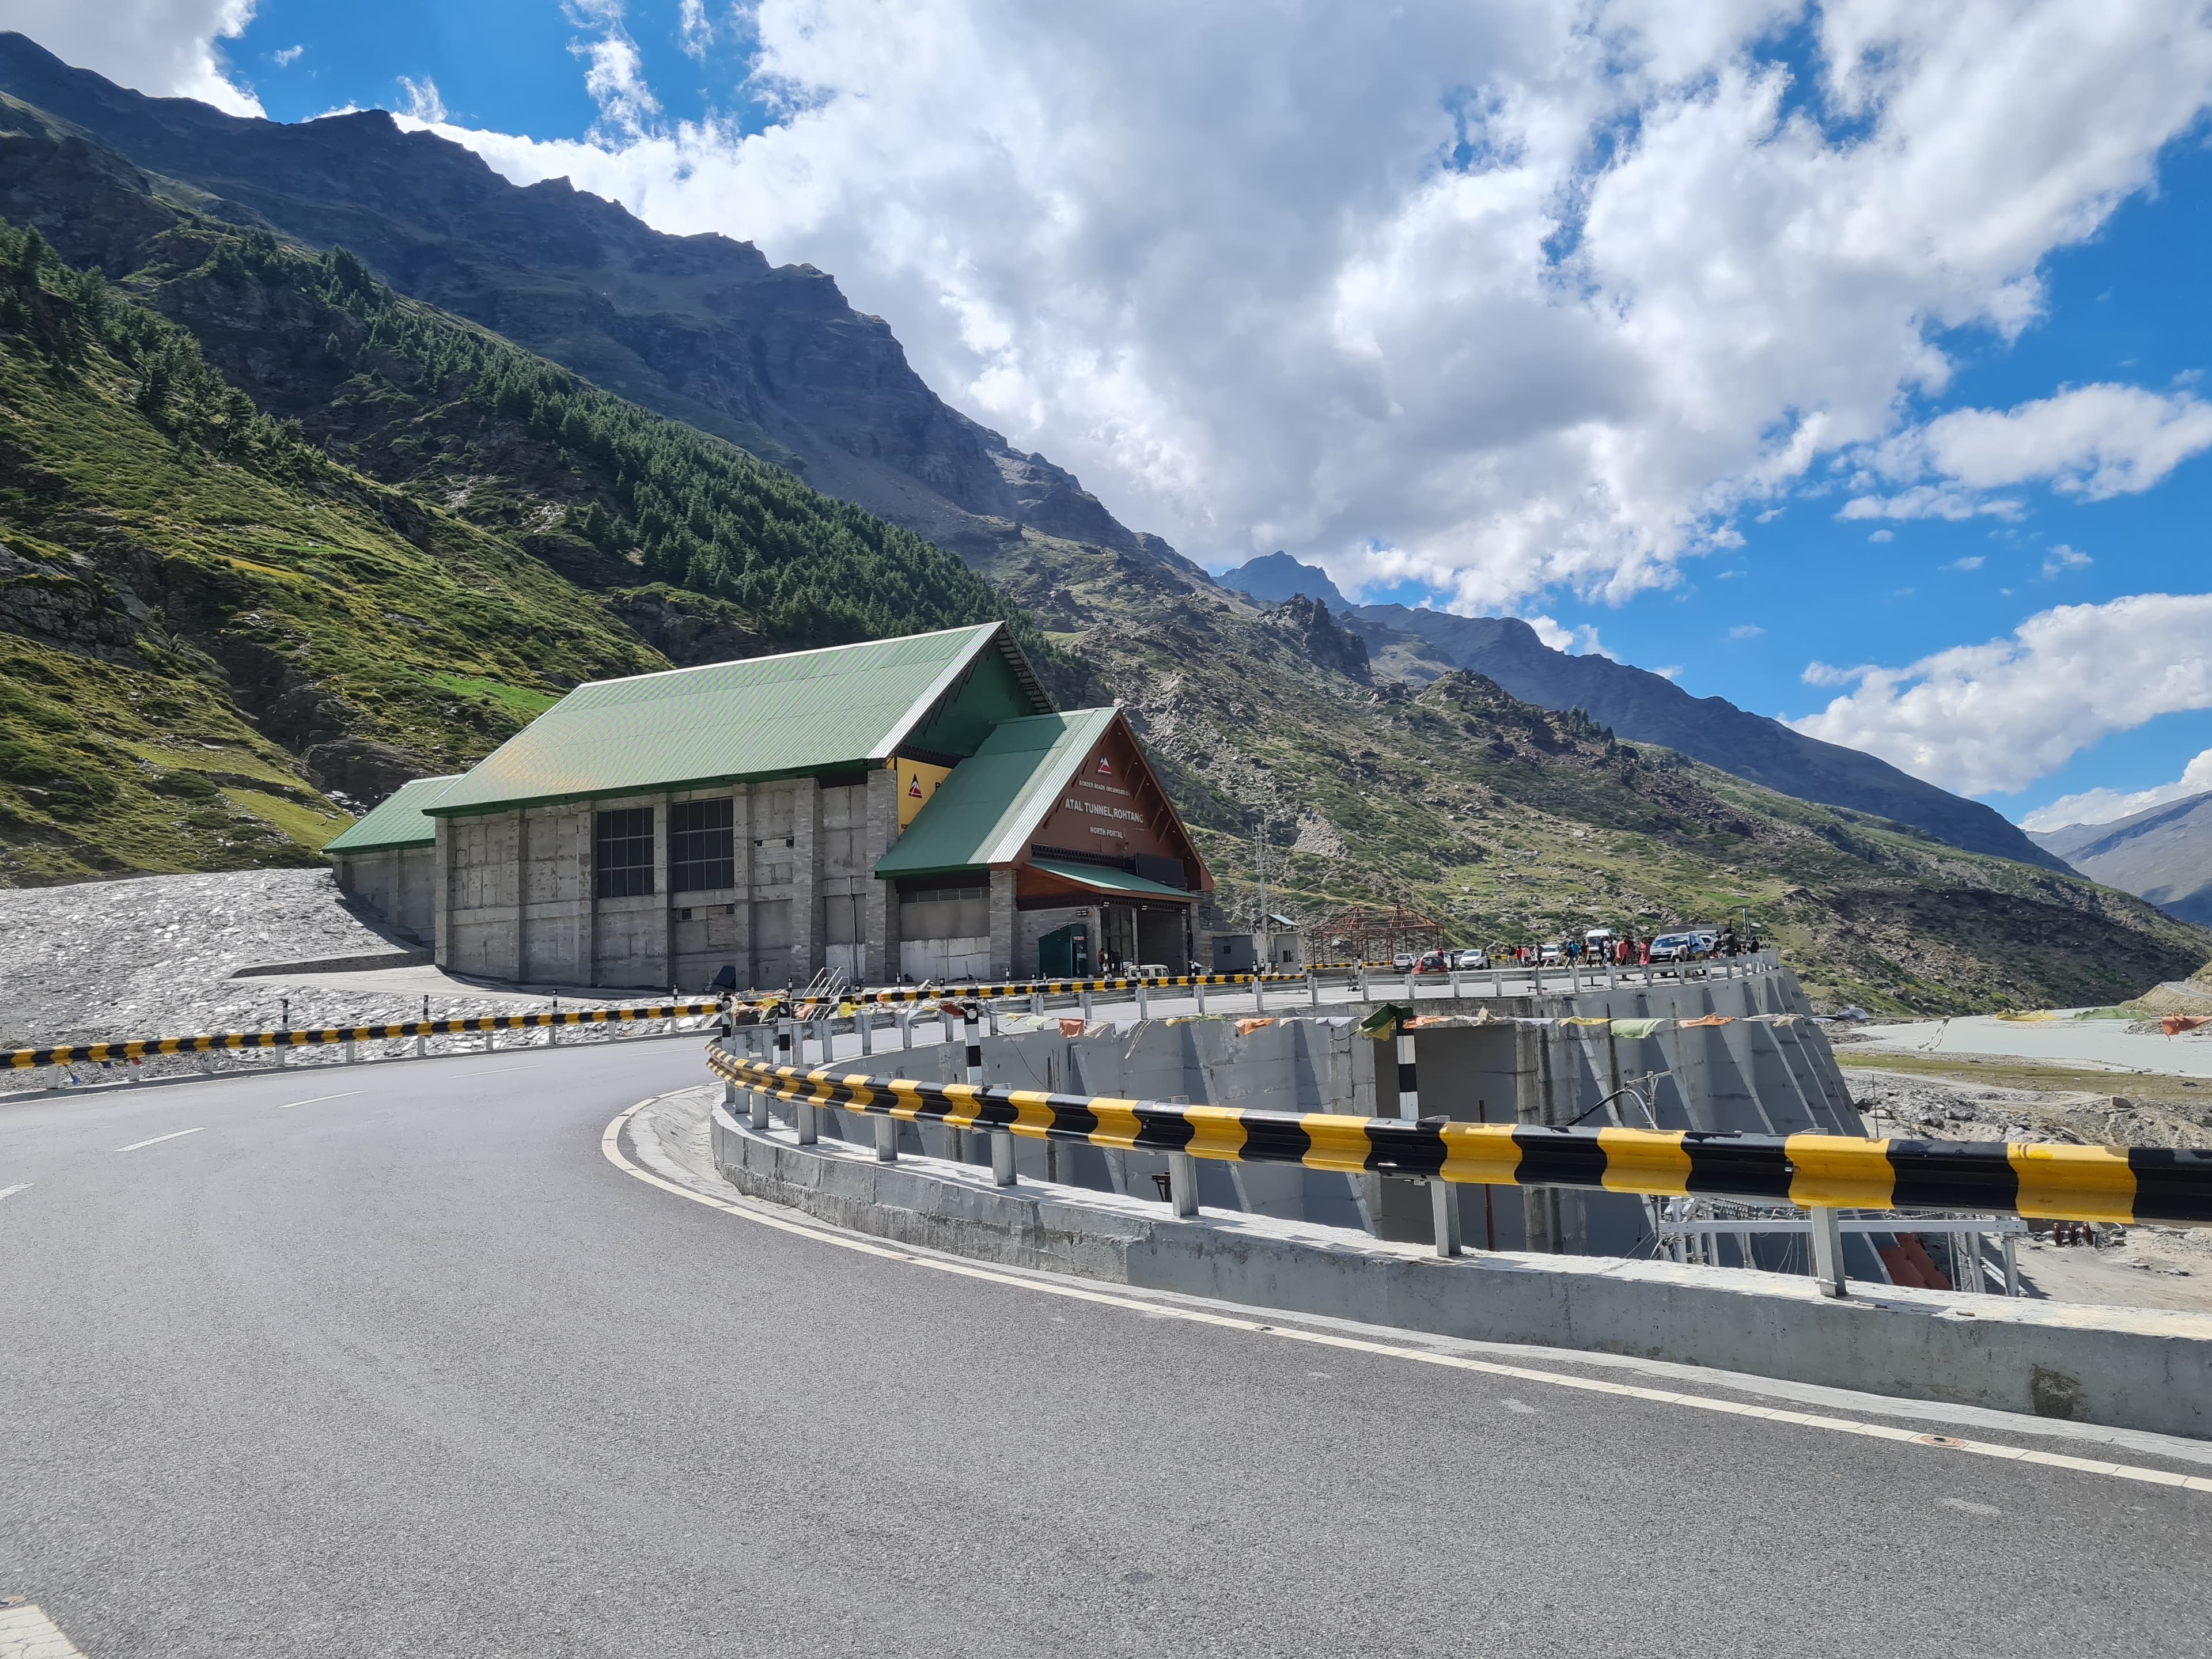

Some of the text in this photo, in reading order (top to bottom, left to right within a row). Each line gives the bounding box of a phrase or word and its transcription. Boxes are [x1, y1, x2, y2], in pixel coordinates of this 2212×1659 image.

[1065, 798, 1083, 812] ATAL
[1090, 826, 1123, 839] NORTH PORTAL
